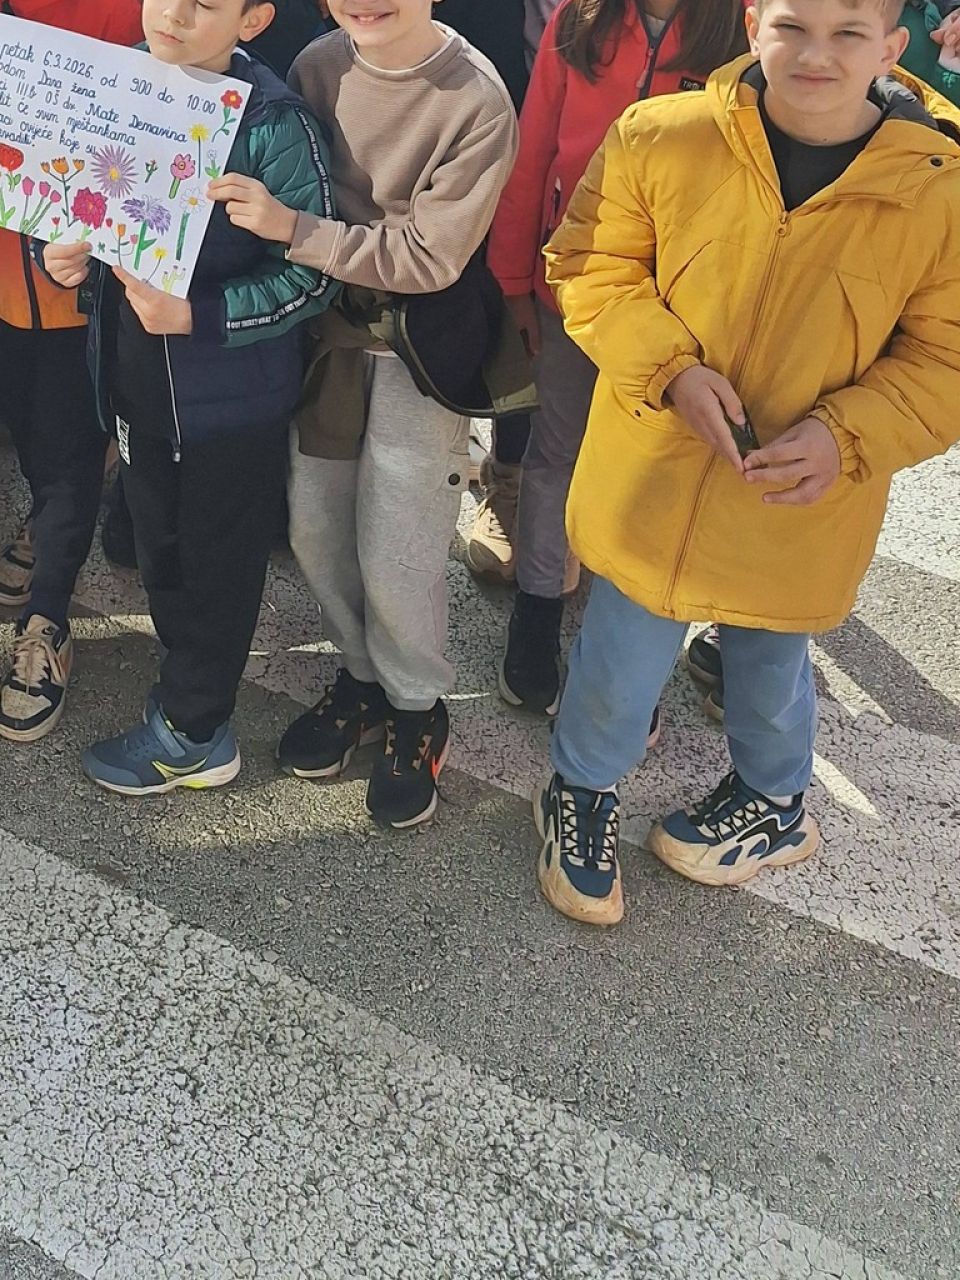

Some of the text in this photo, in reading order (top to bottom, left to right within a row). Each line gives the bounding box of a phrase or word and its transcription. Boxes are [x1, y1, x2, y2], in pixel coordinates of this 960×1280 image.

[0, 41, 35, 63] petak
[43, 51, 93, 79] 6.3.2026.
[100, 73, 118, 89] od
[157, 87, 175, 104] do
[187, 94, 216, 114] 10:00
[38, 71, 62, 90] Dana
[71, 82, 96, 98] žena
[86, 103, 120, 124] Mate
[59, 128, 80, 149] koje
